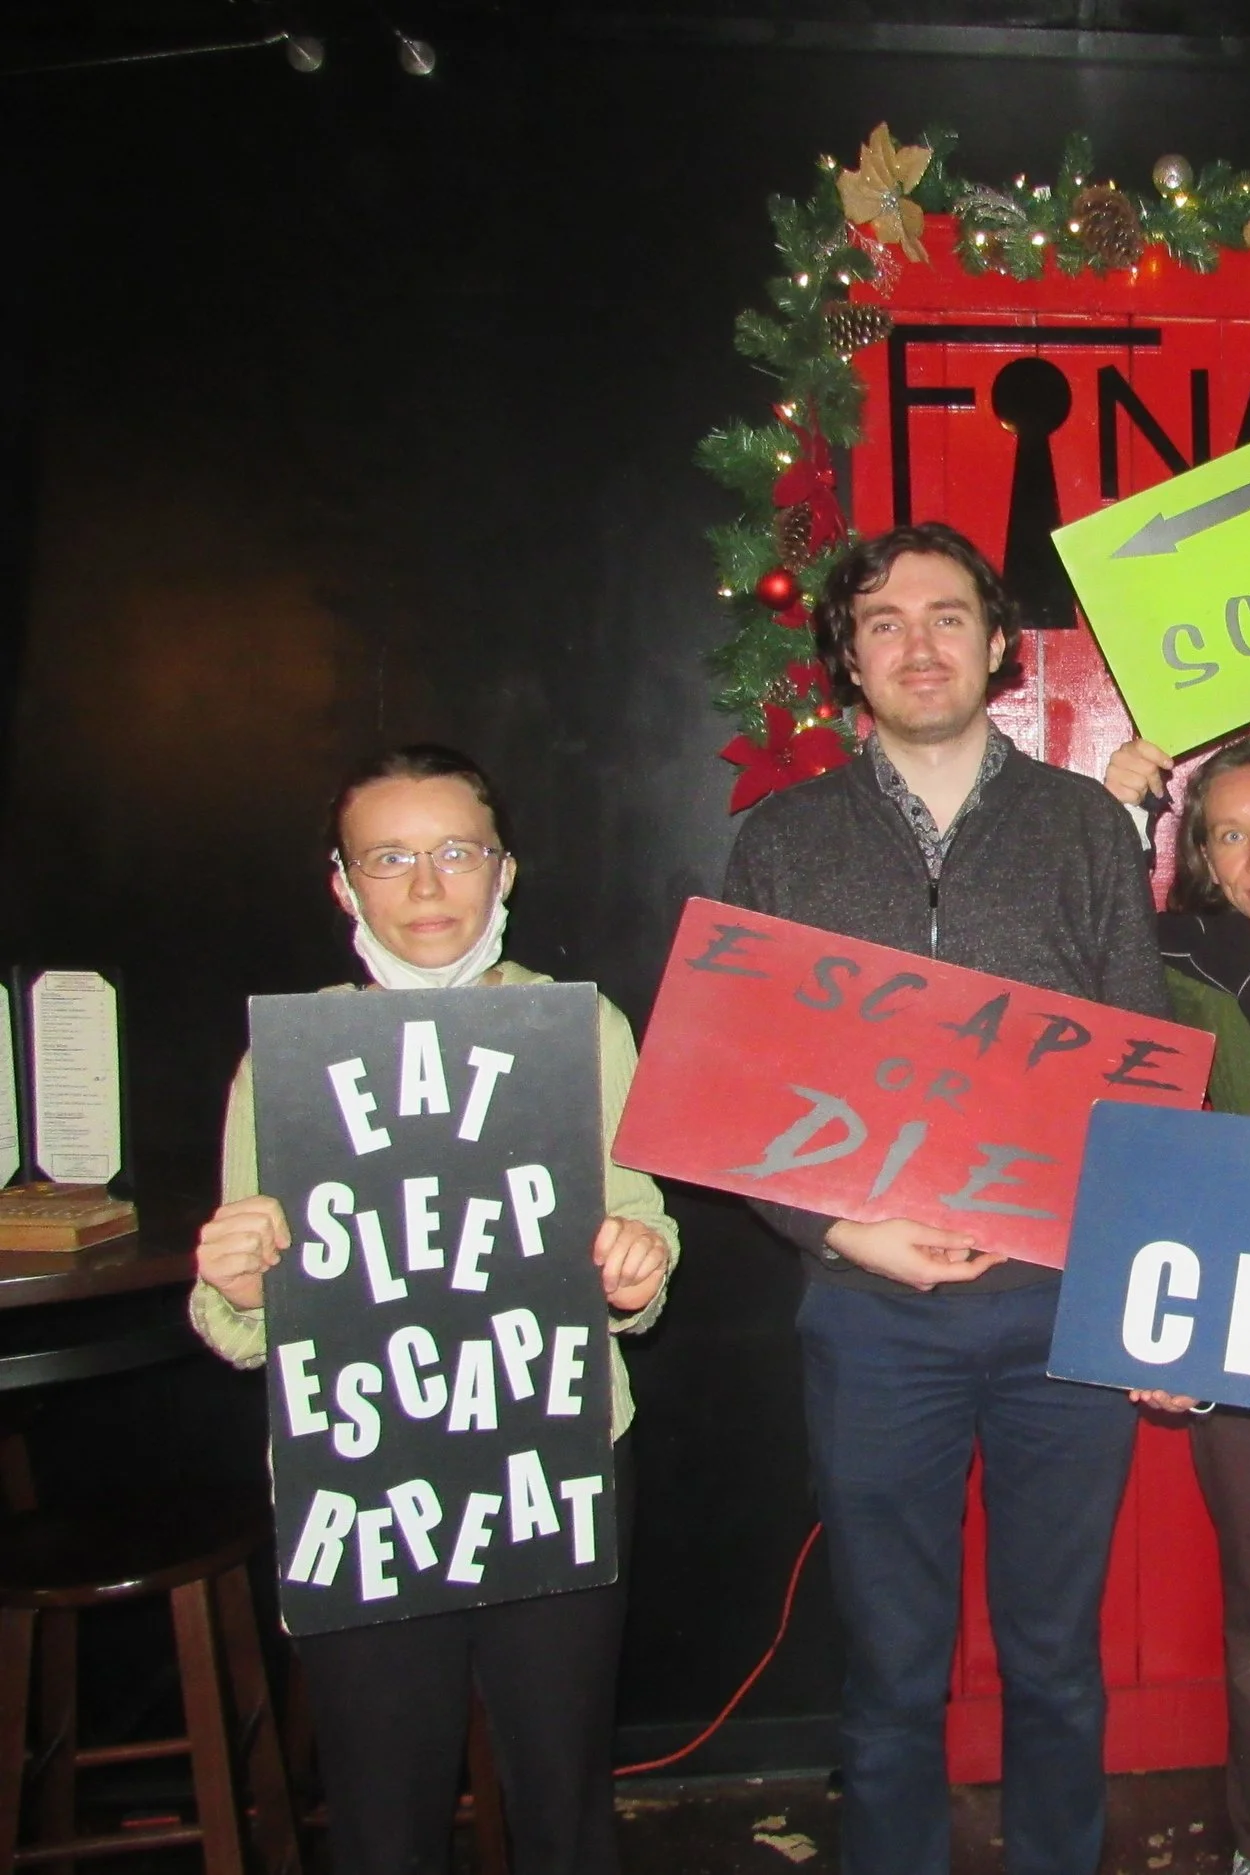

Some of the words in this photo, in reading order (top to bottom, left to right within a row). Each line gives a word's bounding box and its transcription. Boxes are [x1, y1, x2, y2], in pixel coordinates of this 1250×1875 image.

[684, 922, 1187, 1092] ESCAPE
[328, 1020, 515, 1155] EAT
[720, 1083, 1063, 1221] DIE
[876, 1057, 972, 1113] OR
[303, 1164, 557, 1303] SLEEP
[278, 1308, 589, 1459] ESCAPE
[288, 1449, 603, 1600] REPEAT
